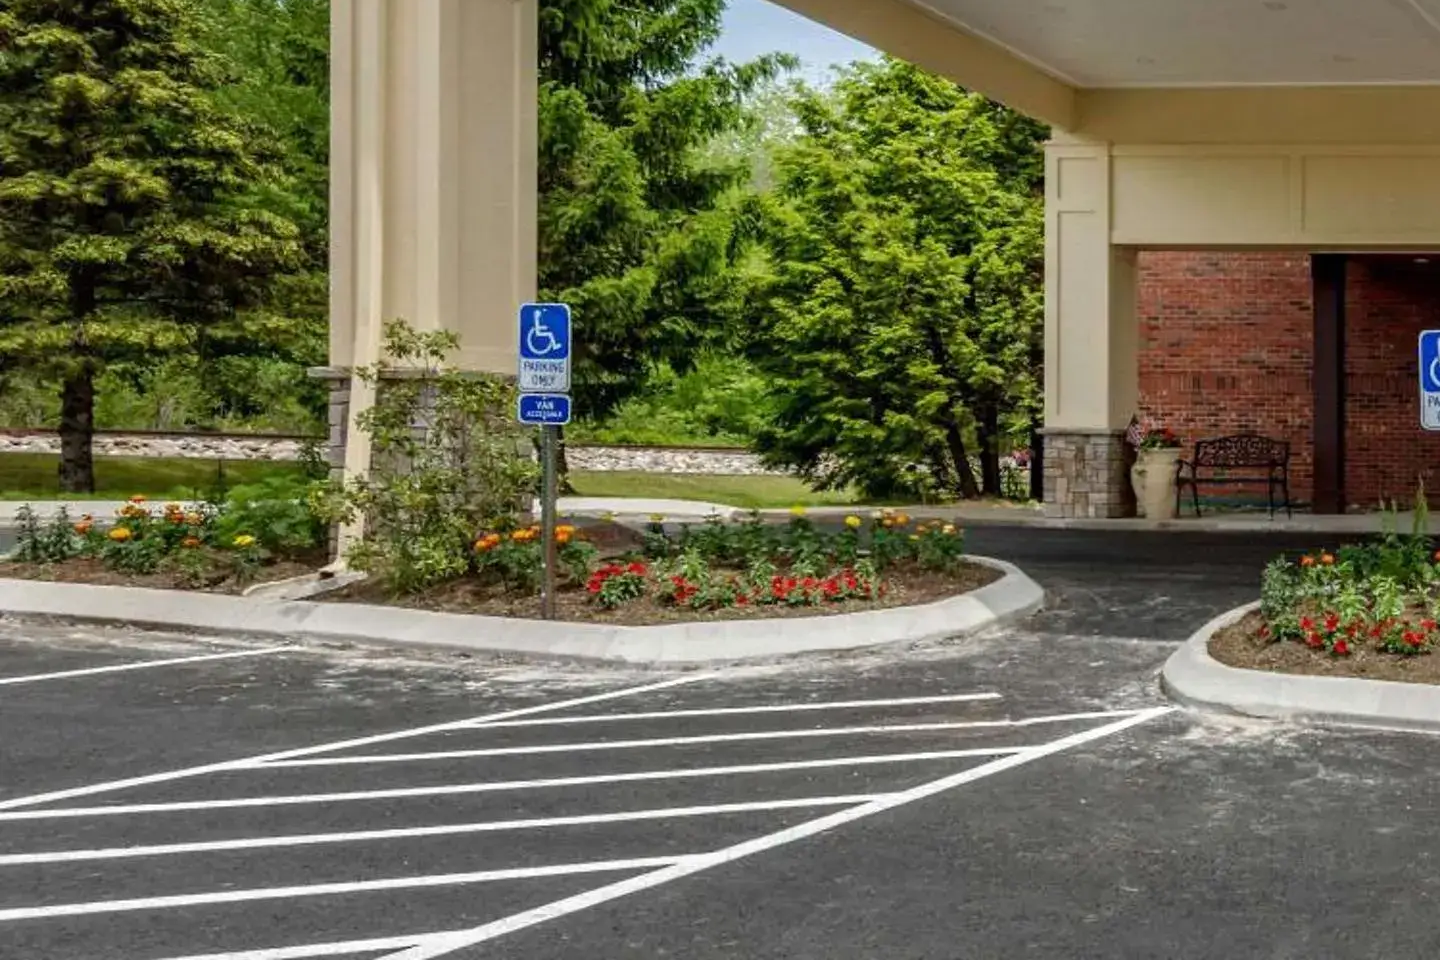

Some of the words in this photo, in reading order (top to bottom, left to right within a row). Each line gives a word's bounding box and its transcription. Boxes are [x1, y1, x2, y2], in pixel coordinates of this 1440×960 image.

[524, 361, 564, 373] PARKING
[531, 374, 556, 386] ONLY
[535, 401, 554, 410] VAN
